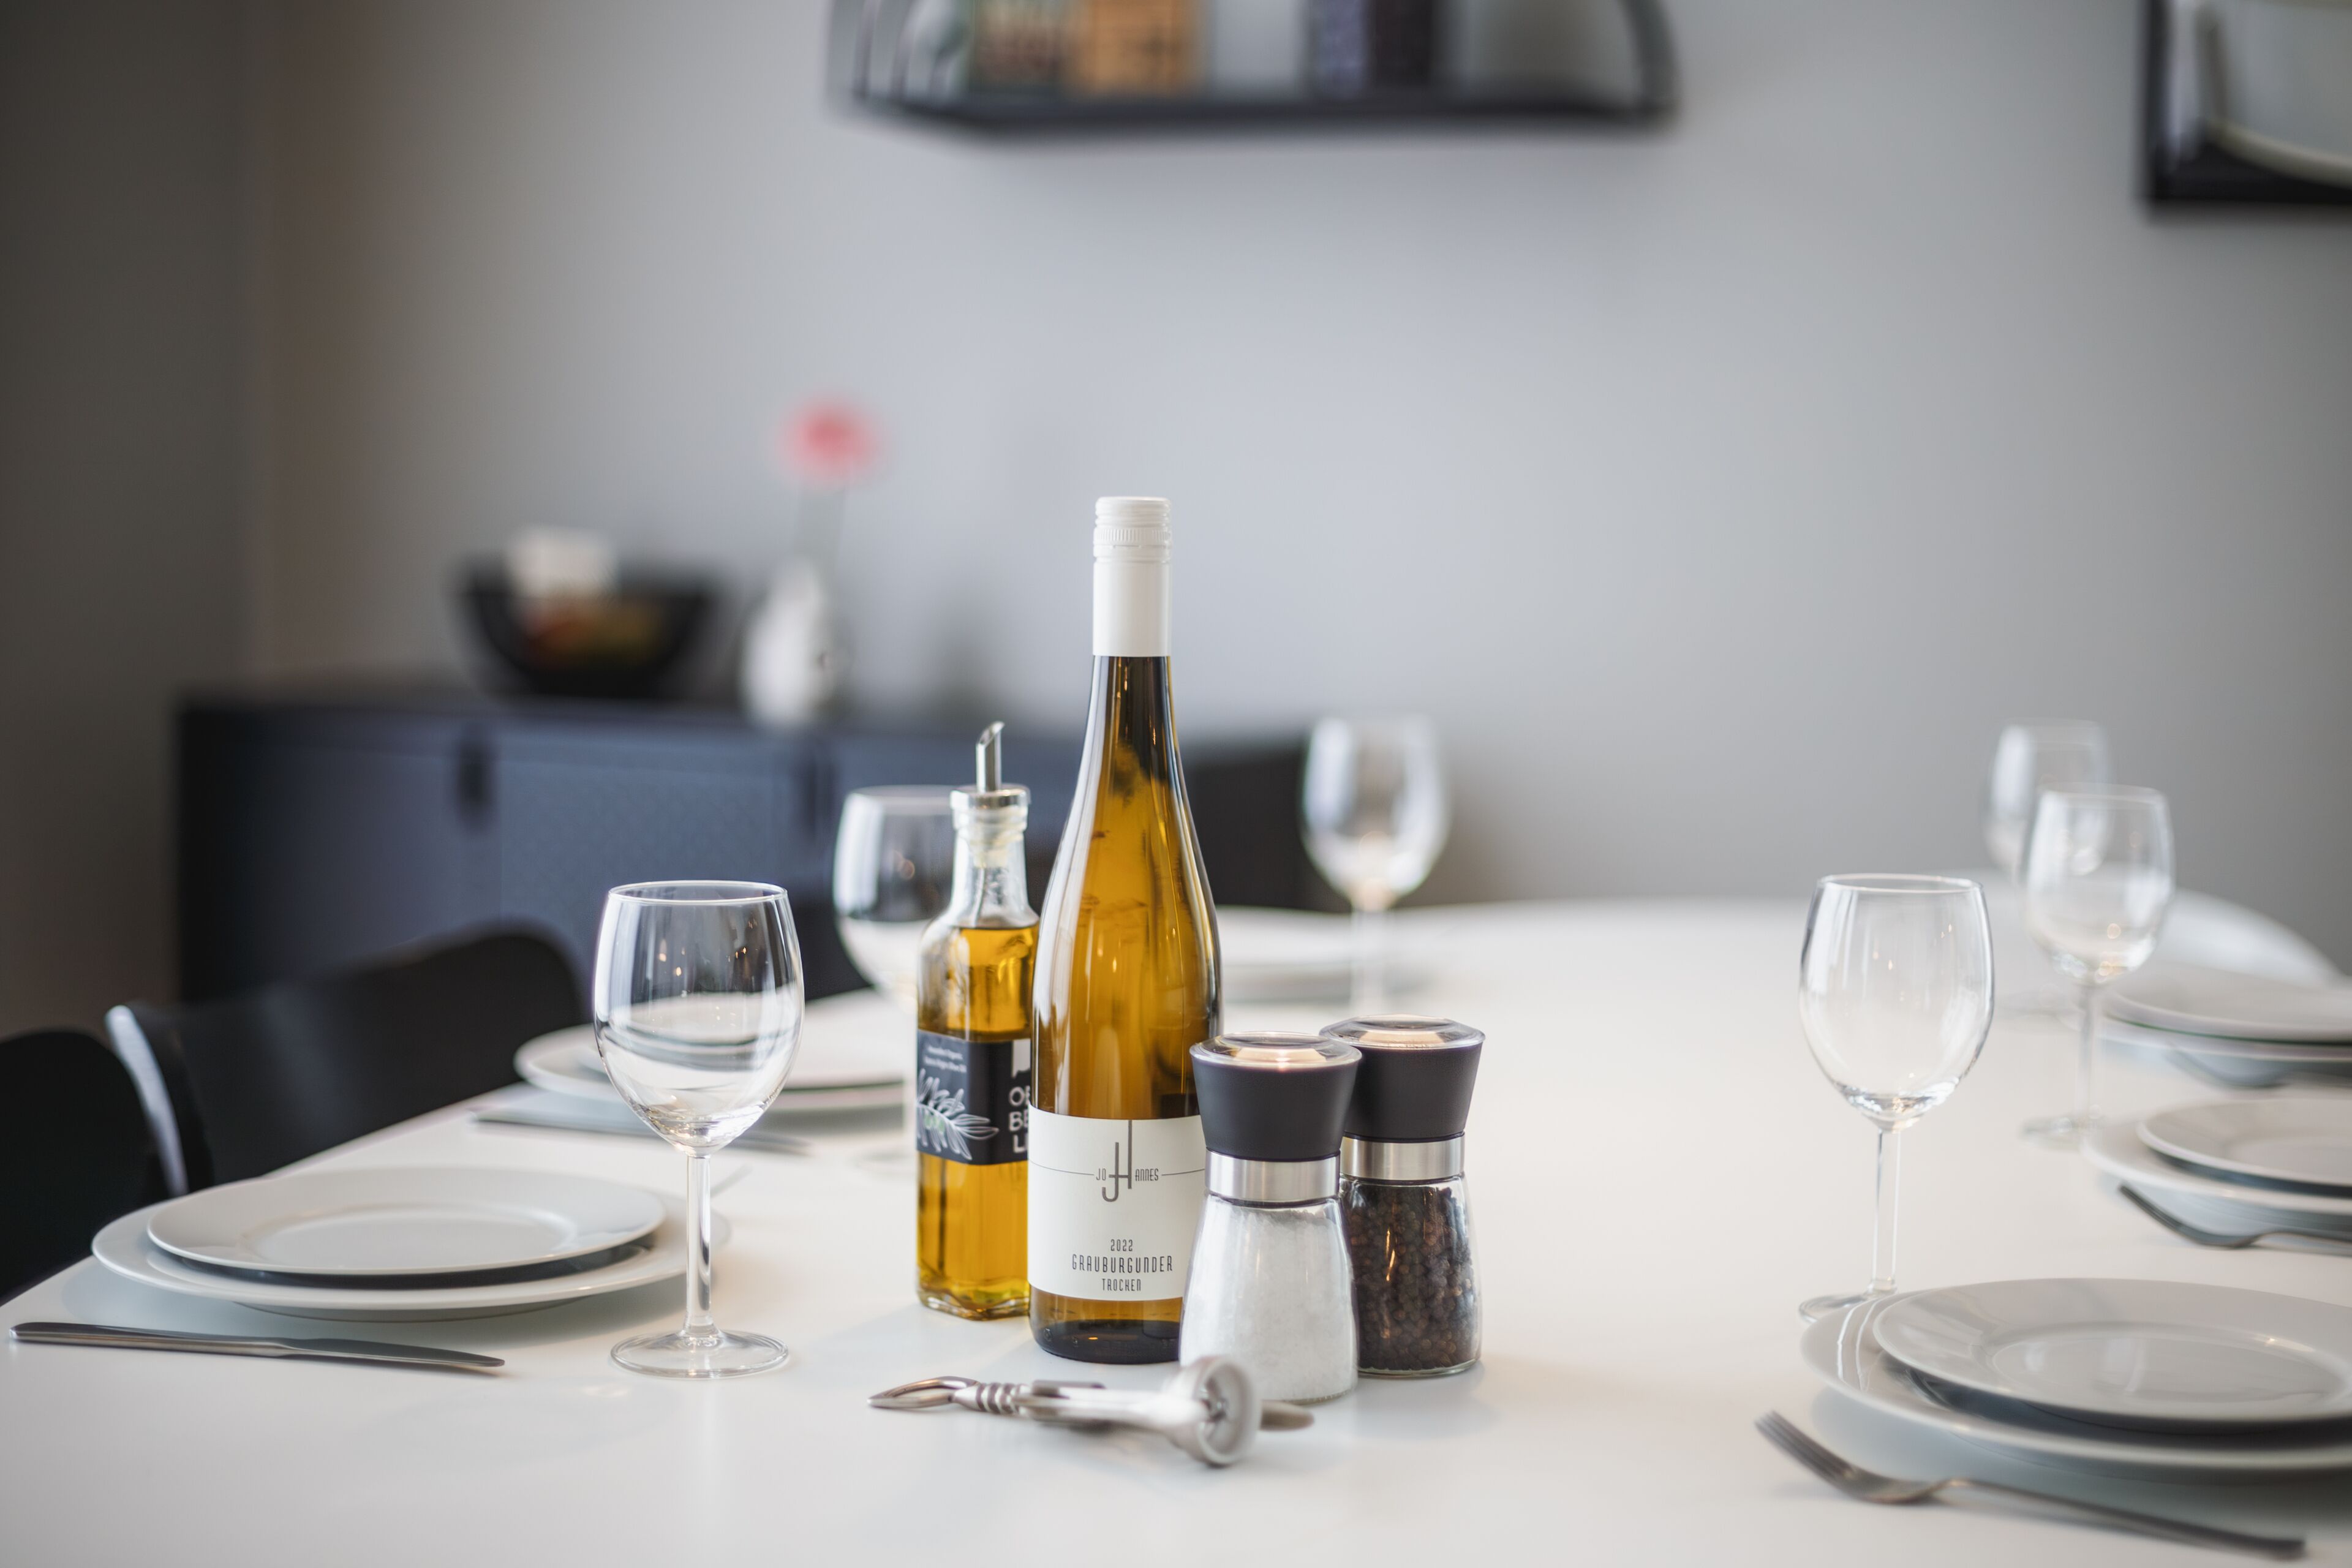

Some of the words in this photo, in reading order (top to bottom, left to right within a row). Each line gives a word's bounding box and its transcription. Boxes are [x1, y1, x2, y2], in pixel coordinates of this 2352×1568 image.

[1110, 1239, 1133, 1251] 2022
[1072, 1254, 1173, 1273] GRAUBURGUNDER
[1102, 1278, 1141, 1291] TROCKEN
